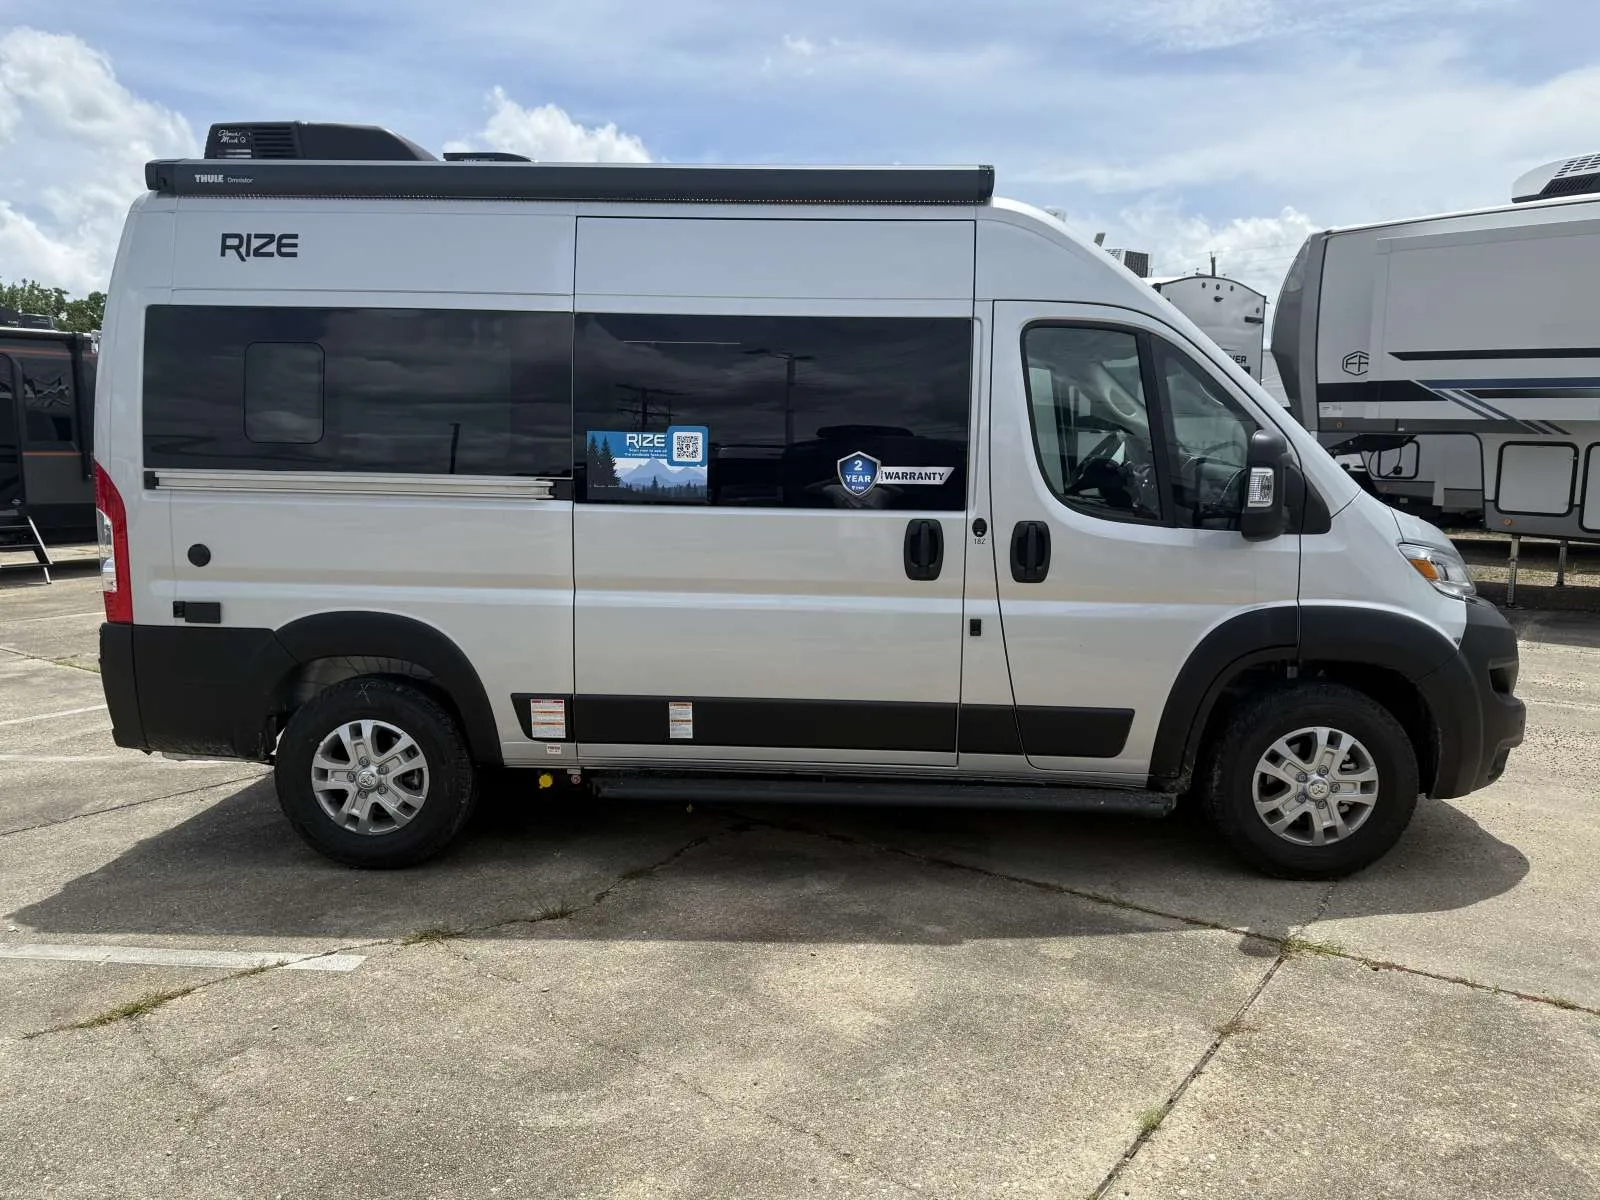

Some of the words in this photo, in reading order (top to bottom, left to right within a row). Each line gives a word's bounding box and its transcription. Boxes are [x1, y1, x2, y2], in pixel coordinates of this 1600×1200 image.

[194, 174, 224, 183] THULE
[220, 233, 299, 262] RIZE
[626, 433, 665, 448] RIZE
[854, 460, 863, 471] 2
[846, 474, 871, 483] YEAR
[884, 471, 945, 481] WARRANTY
